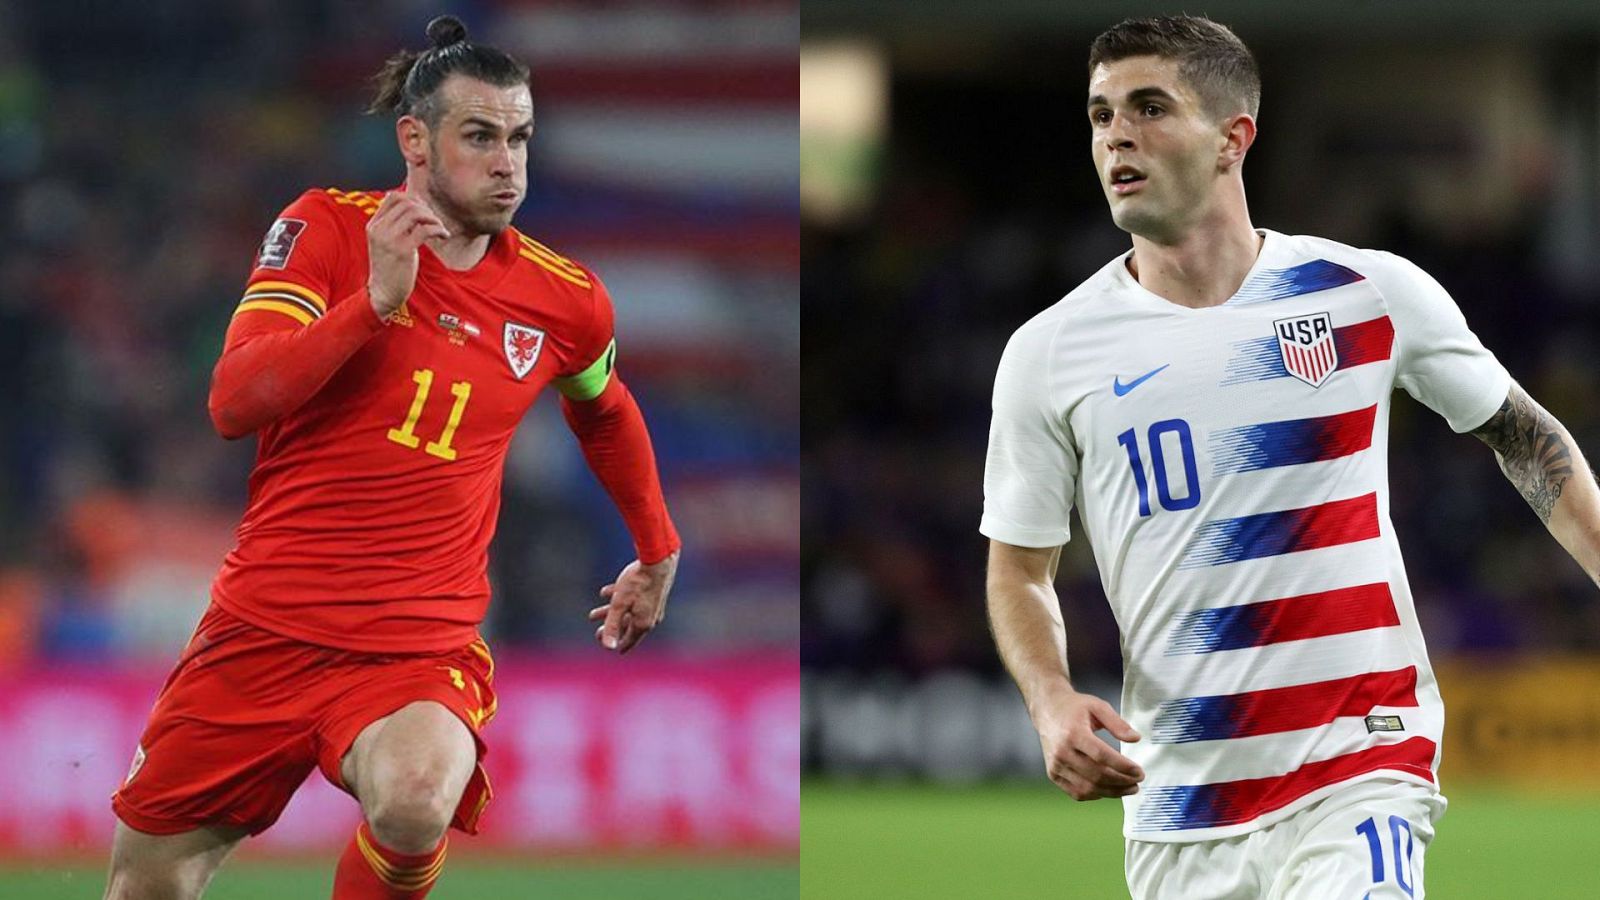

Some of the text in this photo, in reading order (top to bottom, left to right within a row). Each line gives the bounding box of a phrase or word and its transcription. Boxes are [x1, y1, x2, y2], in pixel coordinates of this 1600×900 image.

[1279, 317, 1328, 346] USA
[387, 368, 472, 461] 11
[1117, 418, 1201, 518] 10
[1355, 815, 1414, 900] 10
